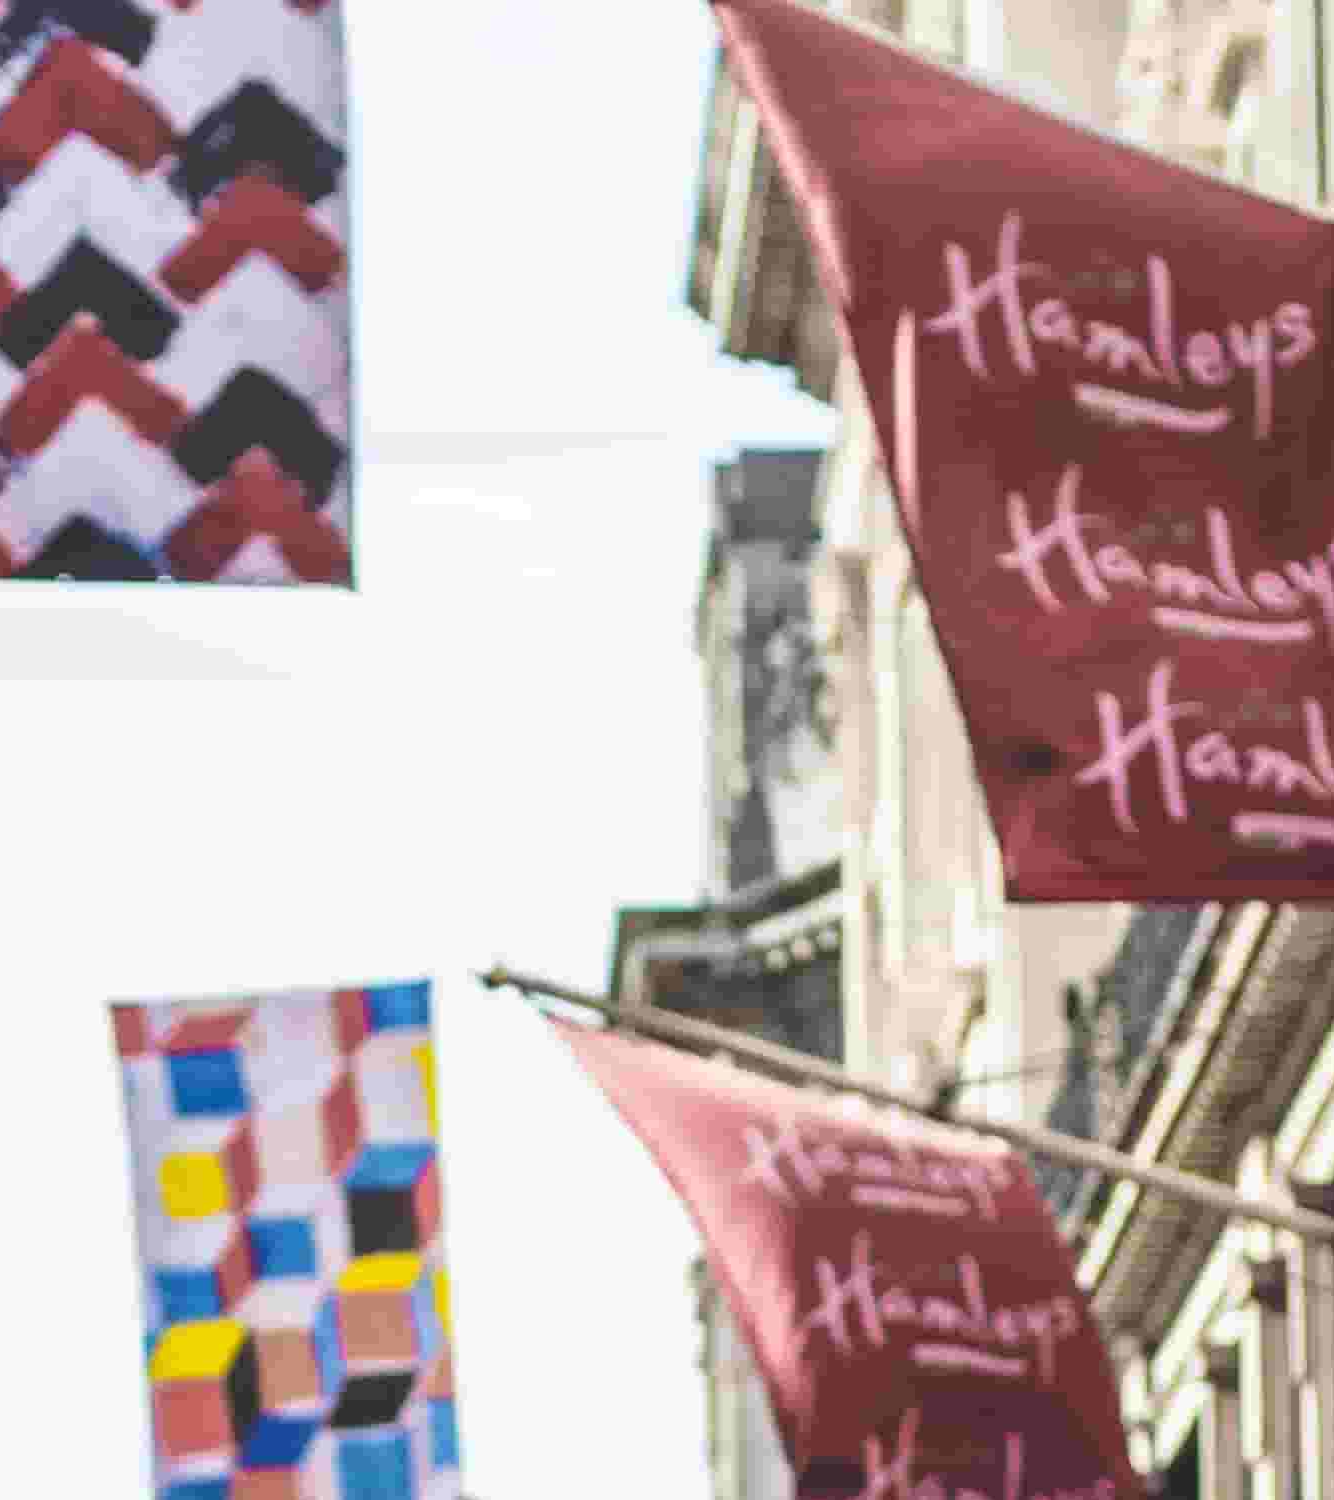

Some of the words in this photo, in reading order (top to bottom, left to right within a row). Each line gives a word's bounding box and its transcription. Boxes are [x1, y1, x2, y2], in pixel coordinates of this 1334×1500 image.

[924, 208, 1317, 440] Hamleys
[743, 1116, 1015, 1221] Hamleys
[799, 1228, 1080, 1386] Hamleys
